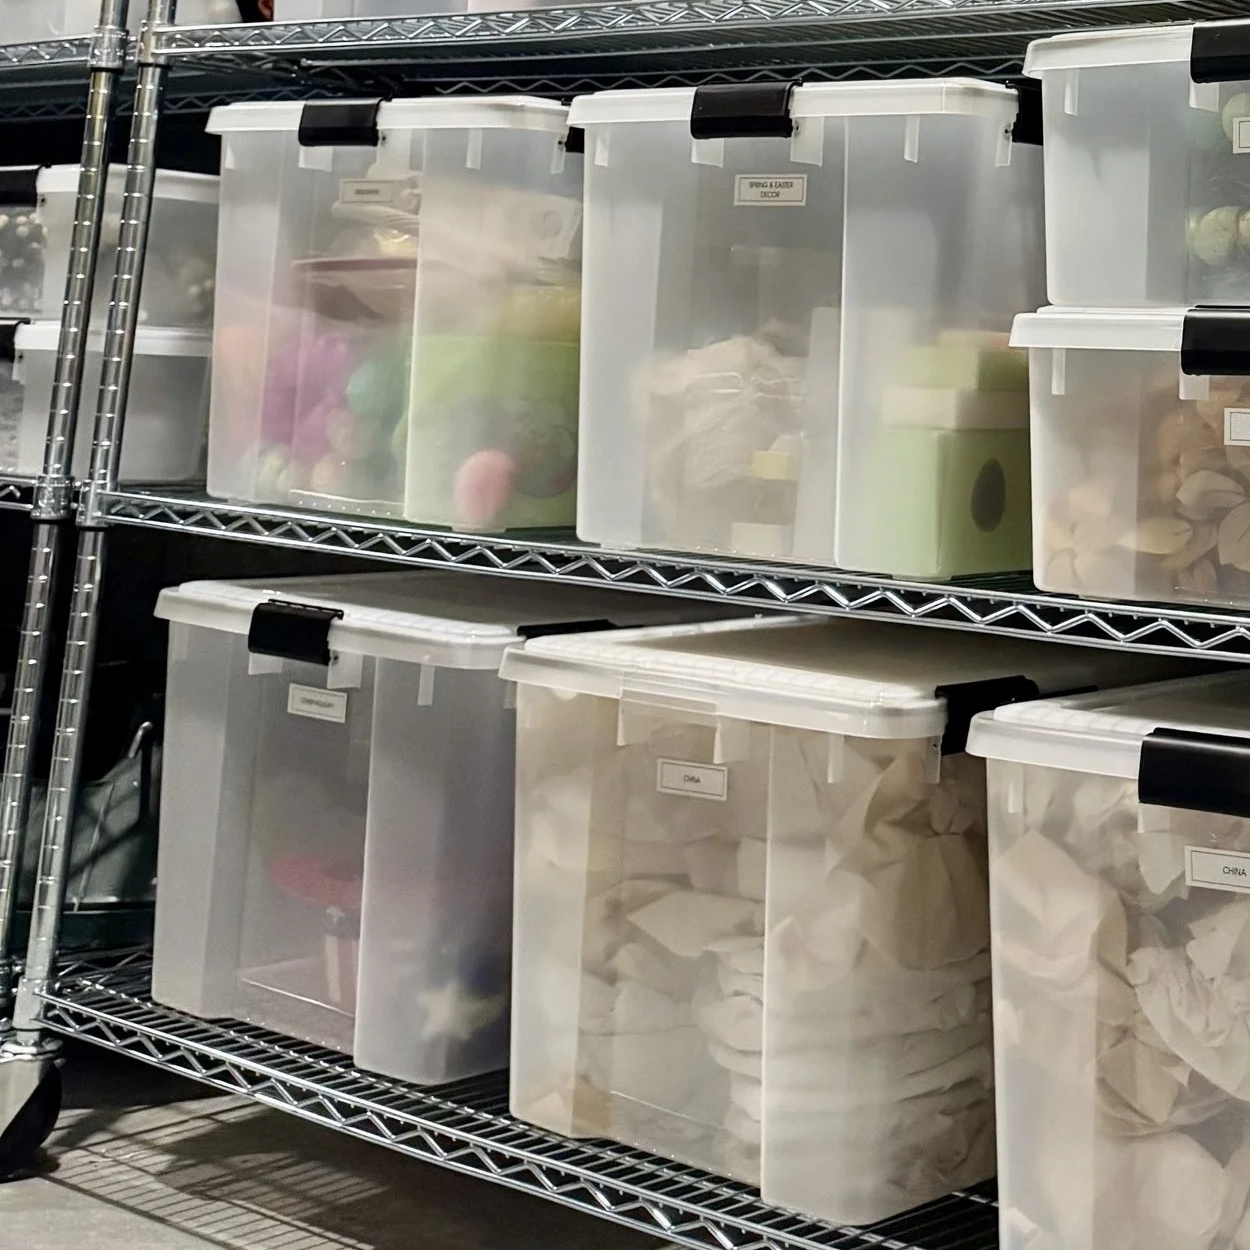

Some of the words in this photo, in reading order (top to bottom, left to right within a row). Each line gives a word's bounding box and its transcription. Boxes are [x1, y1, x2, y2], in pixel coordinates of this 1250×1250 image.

[749, 181, 769, 189] SPRING
[774, 181, 794, 189] EASTER
[760, 191, 781, 199] DECOR
[1222, 866, 1247, 877] CHINA
